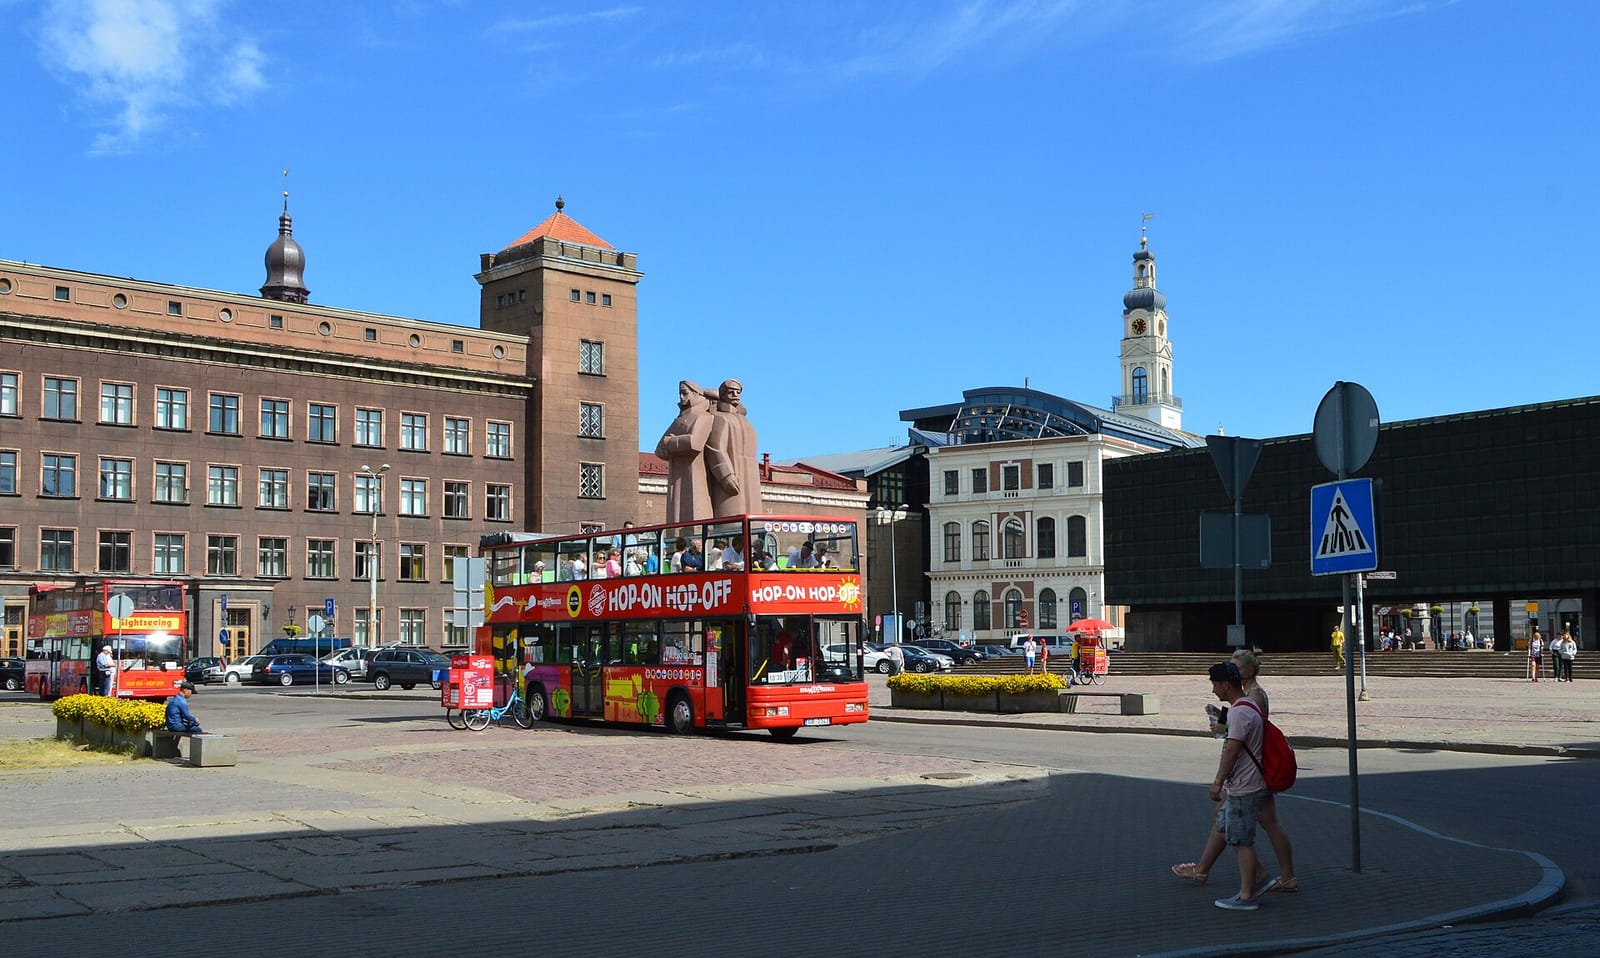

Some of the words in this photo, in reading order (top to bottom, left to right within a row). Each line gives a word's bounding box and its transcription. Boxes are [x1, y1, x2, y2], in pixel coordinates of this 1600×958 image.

[608, 582, 662, 612] HOP-ON
[666, 578, 732, 612] HOP-OFF
[752, 585, 806, 603] HOP-ON
[809, 585, 860, 602] HOP-OFF
